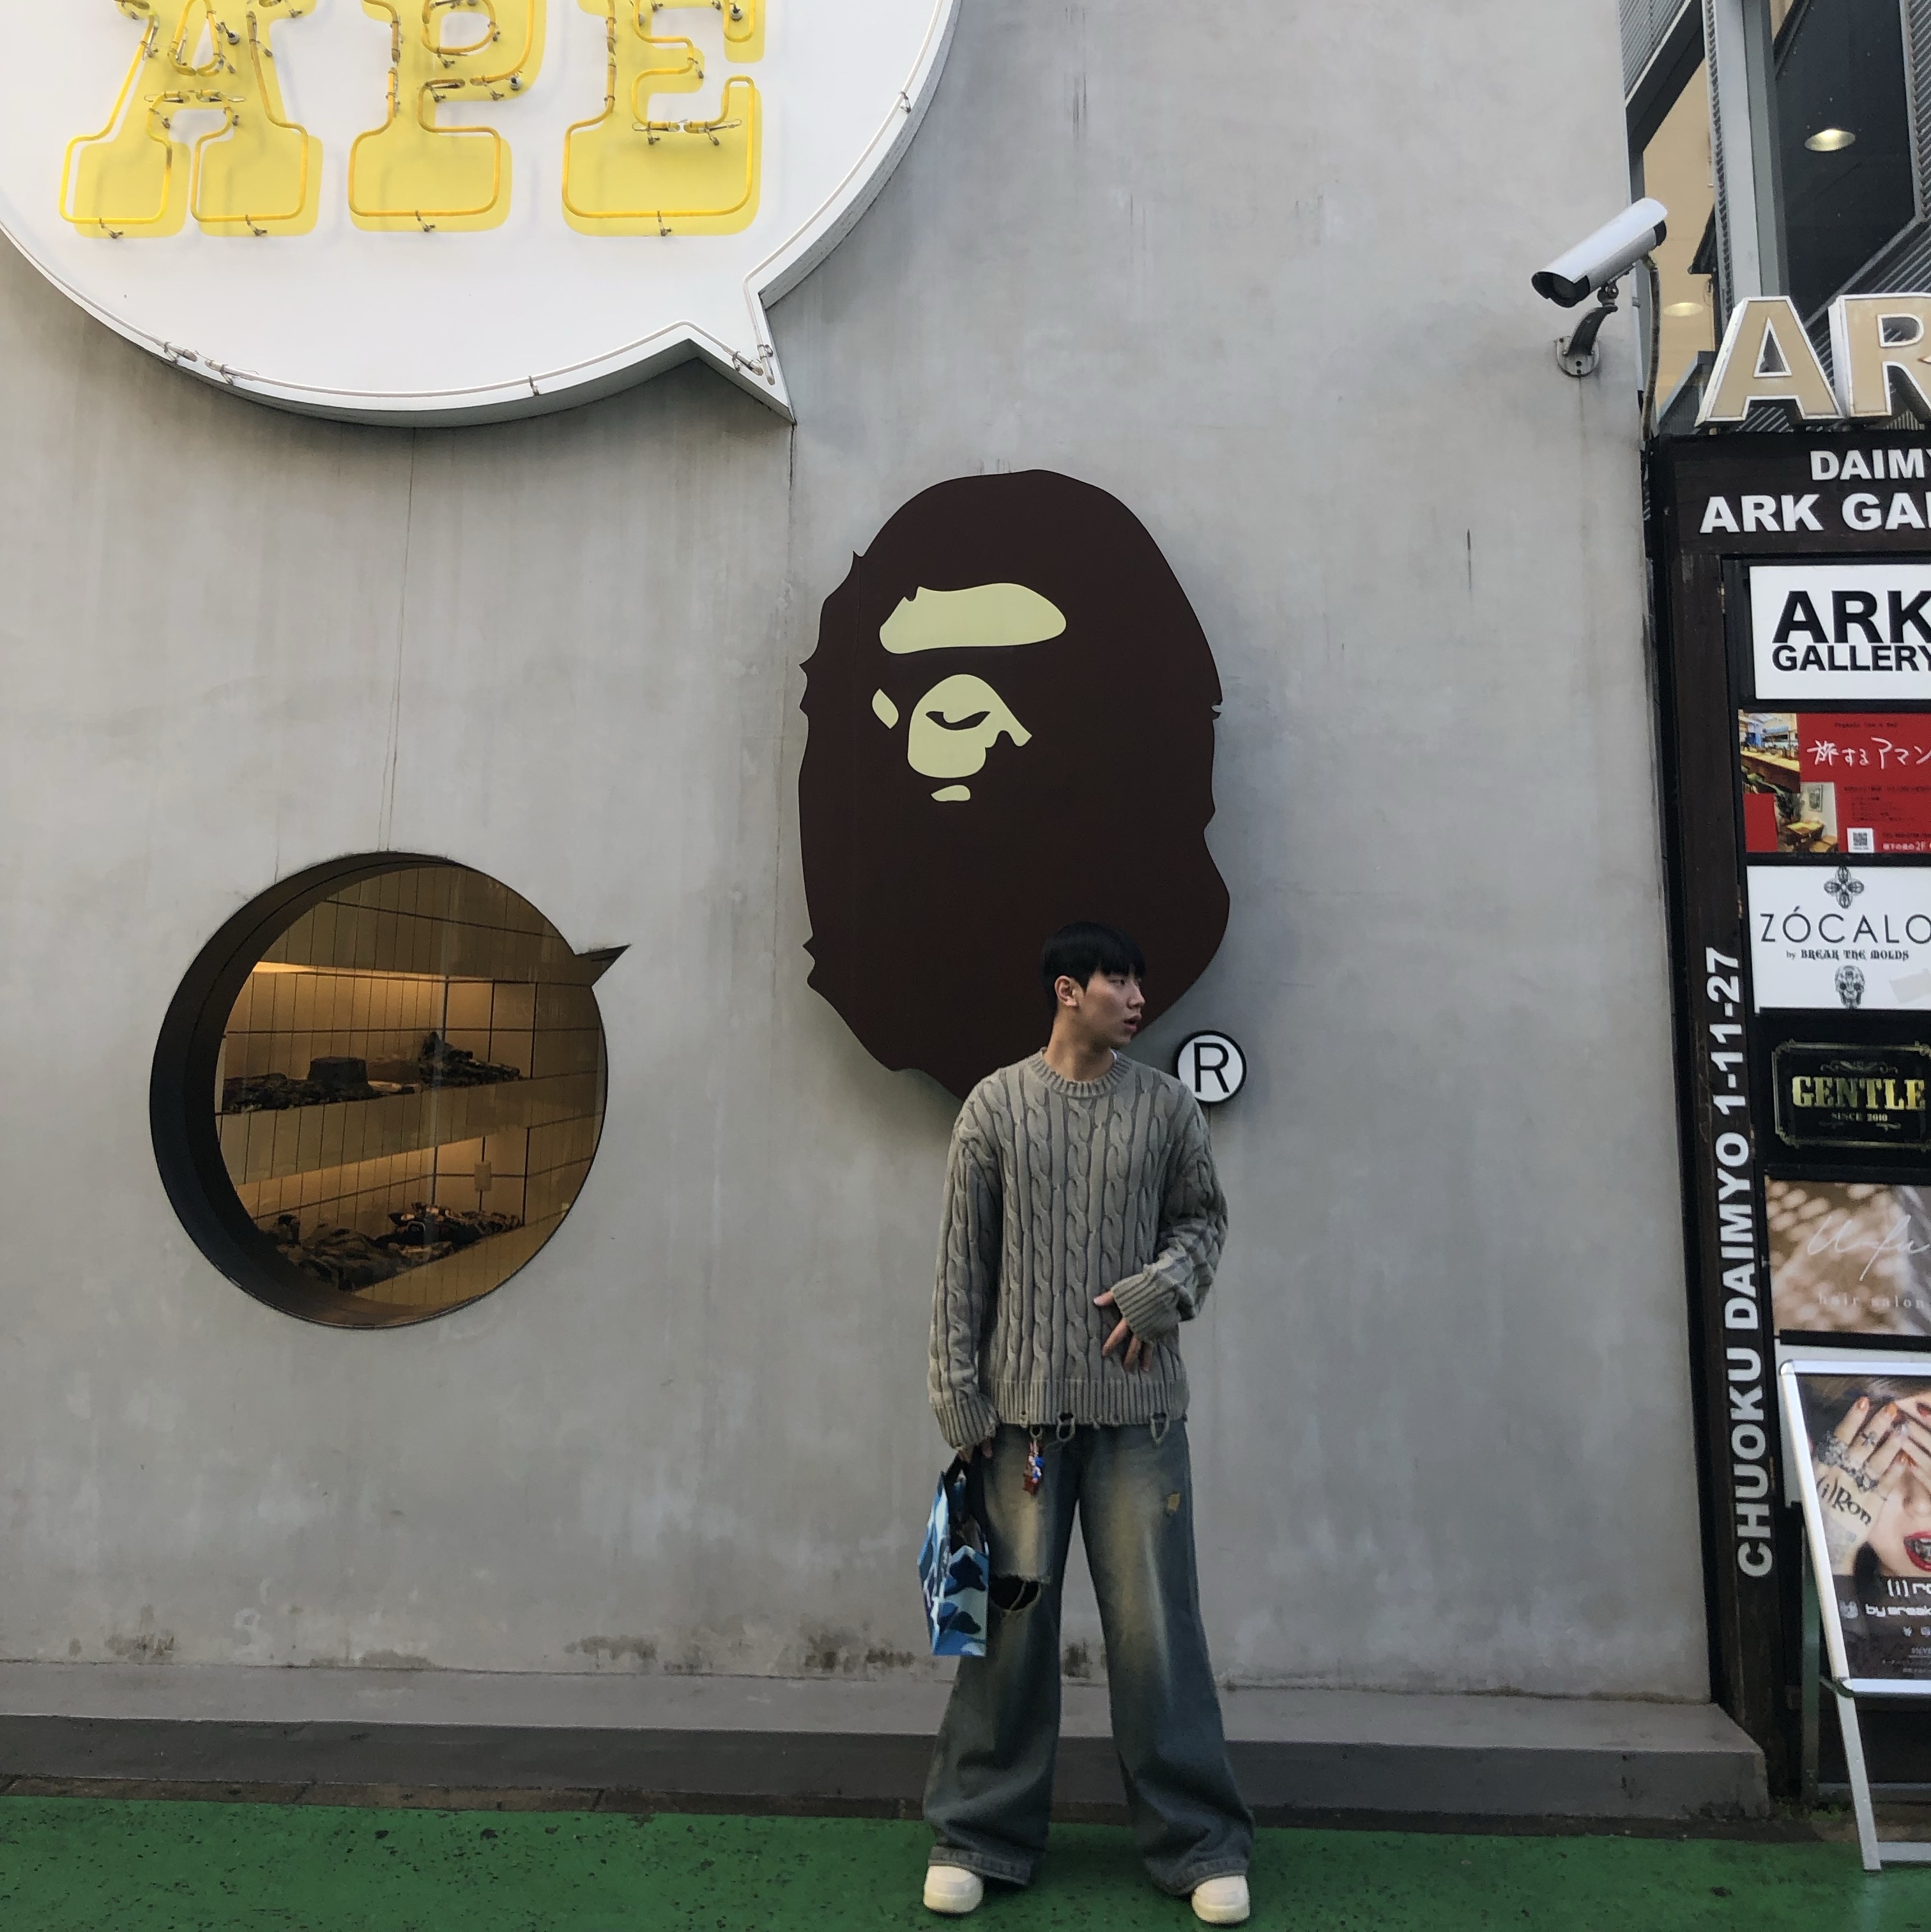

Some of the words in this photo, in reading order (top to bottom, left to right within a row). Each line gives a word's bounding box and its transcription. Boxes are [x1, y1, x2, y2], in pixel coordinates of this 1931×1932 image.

[60, 0, 761, 238] APE
[1696, 292, 1931, 425] AR
[1810, 449, 1931, 480] DAIM
[1700, 494, 1824, 533] ARK
[1842, 492, 1931, 531] GA
[1771, 590, 1931, 643] ARK
[1760, 905, 1931, 944] ZÓCALO
[1786, 950, 1796, 959] by
[1801, 949, 1839, 961] BREAK
[1705, 946, 1746, 1116] 1-11-27
[1716, 1131, 1759, 1330] DAIMYO
[1726, 1347, 1773, 1577] CHUOKU
